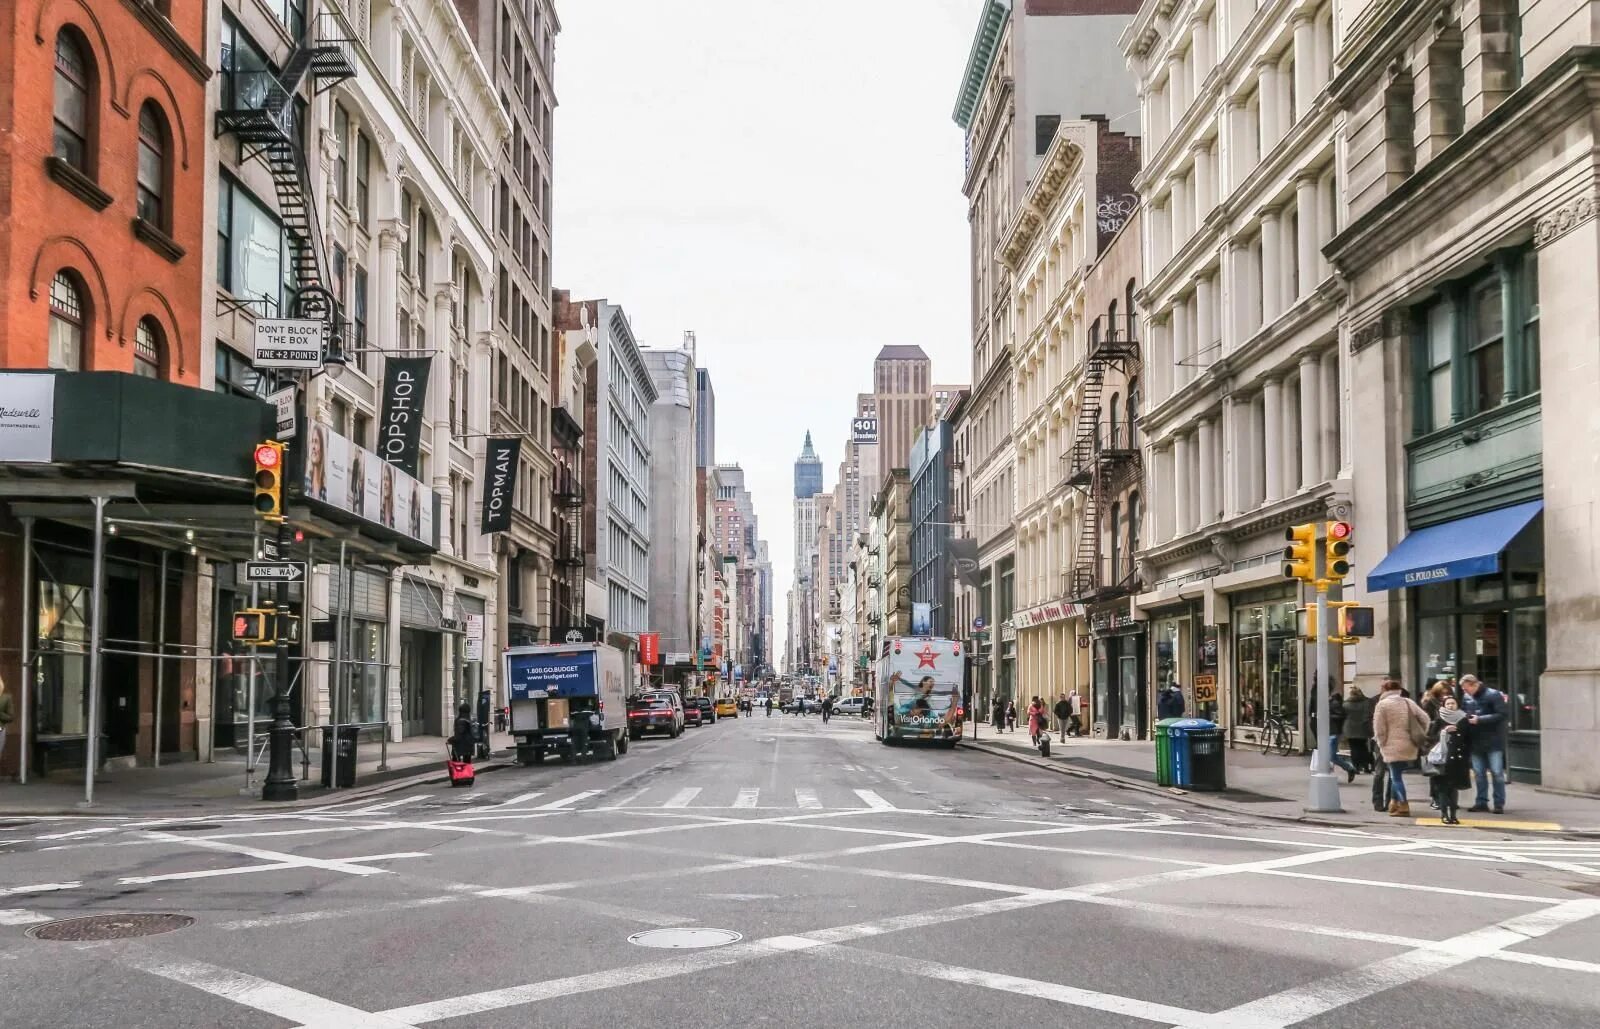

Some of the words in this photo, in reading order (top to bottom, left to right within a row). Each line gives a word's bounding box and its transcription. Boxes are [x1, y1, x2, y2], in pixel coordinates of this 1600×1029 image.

[258, 325, 285, 334] DON'T
[288, 326, 318, 335] BLOCK
[267, 336, 286, 344] THE
[289, 336, 309, 345] BOX
[257, 350, 274, 359] FINE
[276, 351, 288, 359] +2
[290, 351, 317, 360] POINTS
[386, 370, 415, 462] TOPSHOP
[854, 420, 876, 430] 401
[855, 432, 876, 441] Broadway
[488, 449, 511, 522] TOPMAN
[254, 567, 271, 576] ONE
[279, 568, 297, 576] WAY
[1415, 570, 1431, 580] POLO
[526, 666, 579, 674] 1.800.GO.BUDGET
[526, 673, 579, 681] www.budget.com
